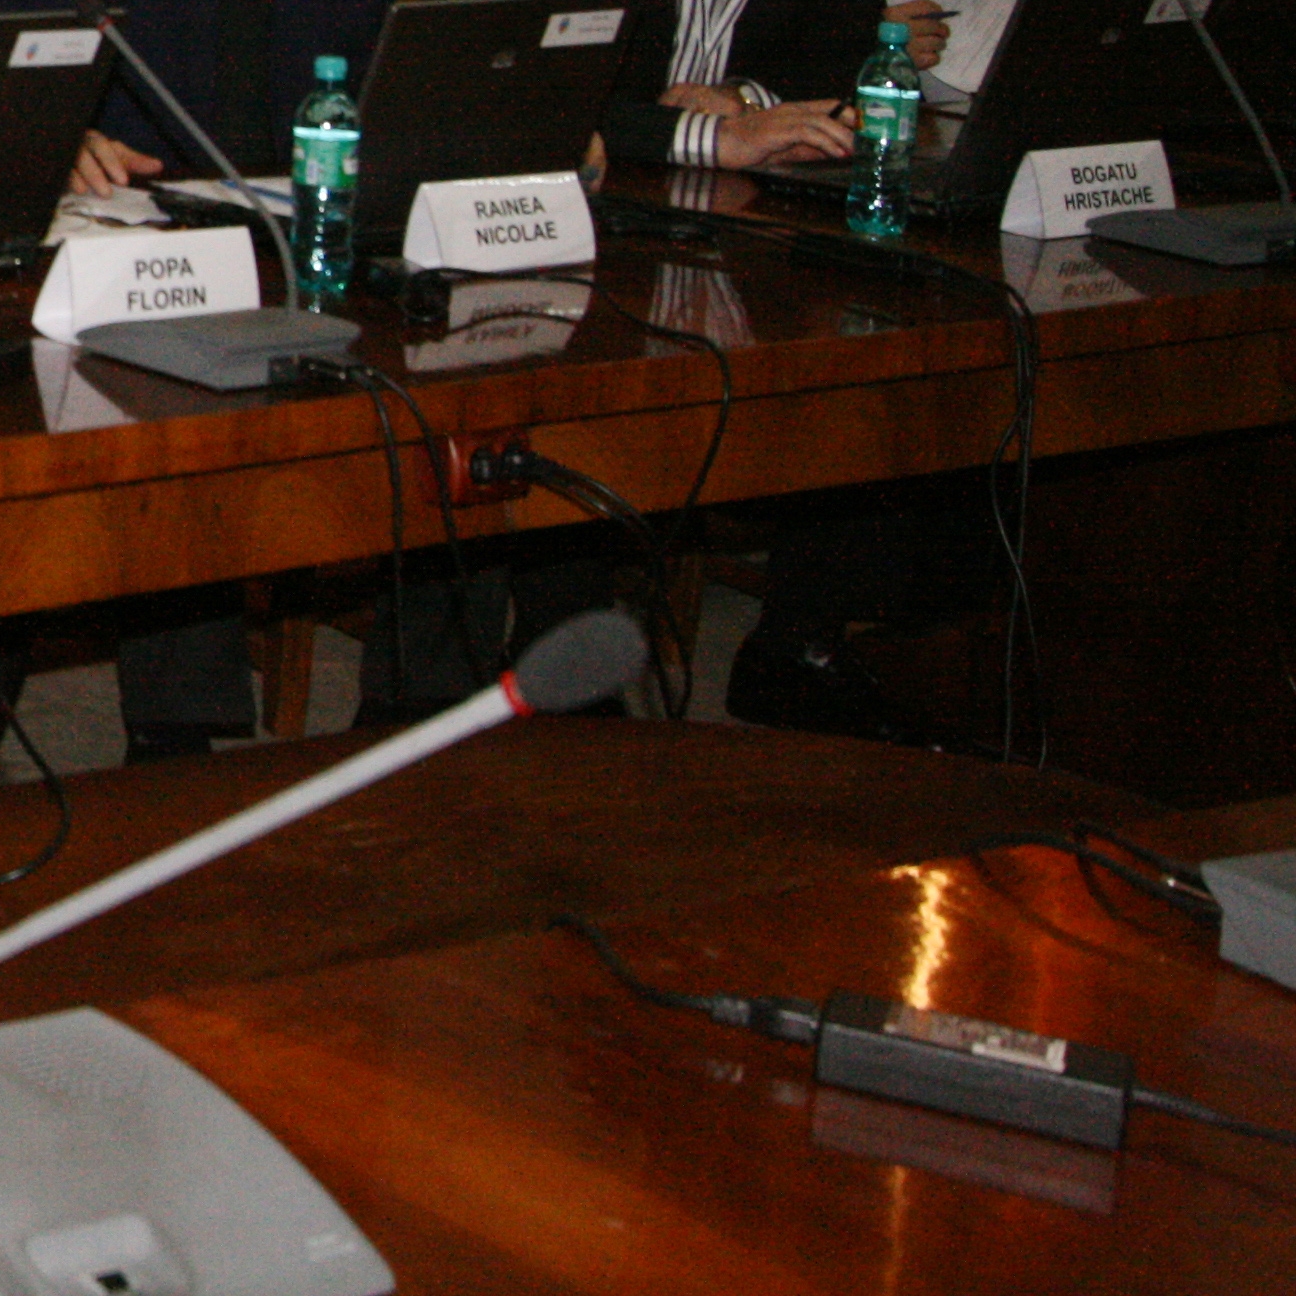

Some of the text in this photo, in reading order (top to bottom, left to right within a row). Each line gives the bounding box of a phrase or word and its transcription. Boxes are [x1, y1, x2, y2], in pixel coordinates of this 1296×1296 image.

[1070, 162, 1138, 185] BOGATU
[473, 196, 546, 219] RAINEA
[1063, 185, 1155, 211] HRISTACHE
[475, 221, 559, 246] NICOLAE
[134, 257, 195, 280] POPA
[126, 286, 207, 312] FLORIN
